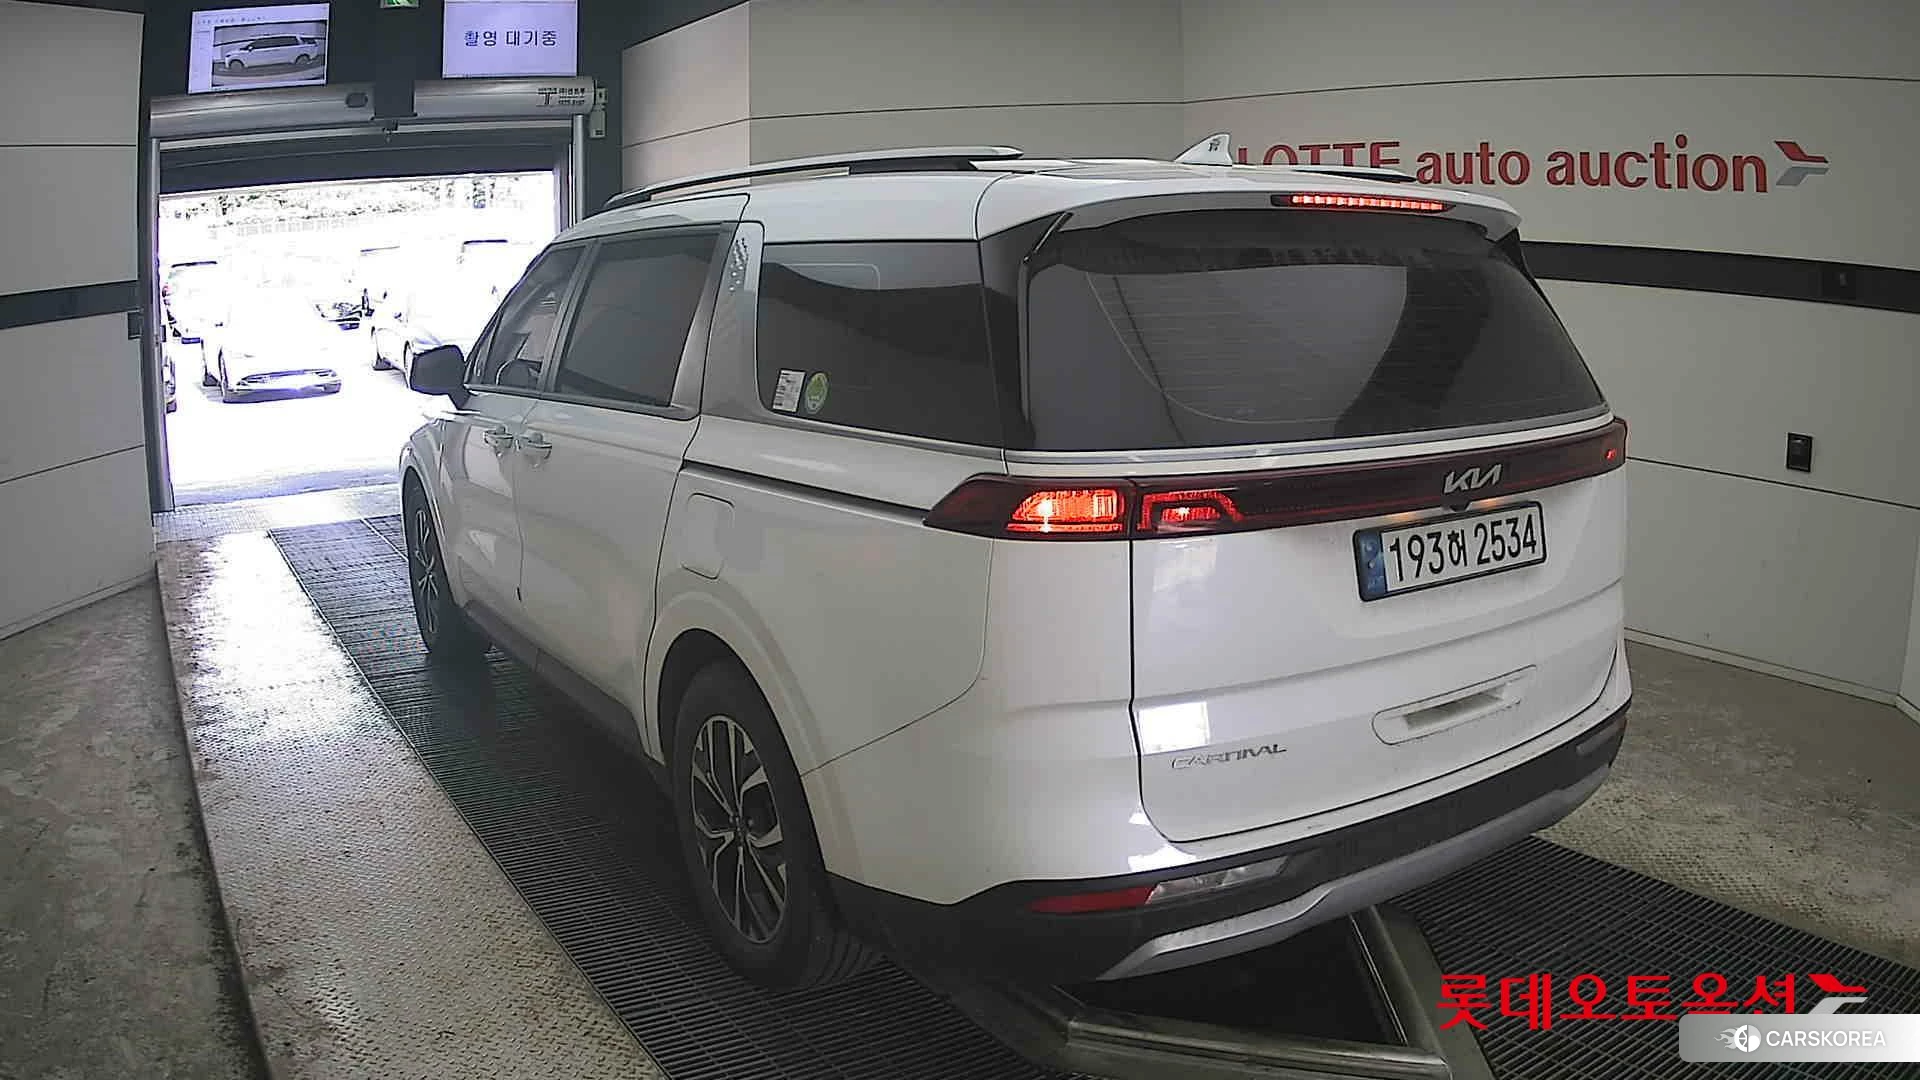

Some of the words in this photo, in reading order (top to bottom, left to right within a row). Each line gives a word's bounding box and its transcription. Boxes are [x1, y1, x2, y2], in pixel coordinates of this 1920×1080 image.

[506, 30, 557, 47] 대기중
[1415, 142, 1531, 185] auto
[1546, 134, 1768, 193] auction
[1389, 529, 1468, 582] 193허
[1474, 514, 1538, 565] 2534
[1171, 743, 1287, 770] CARNIVAL
